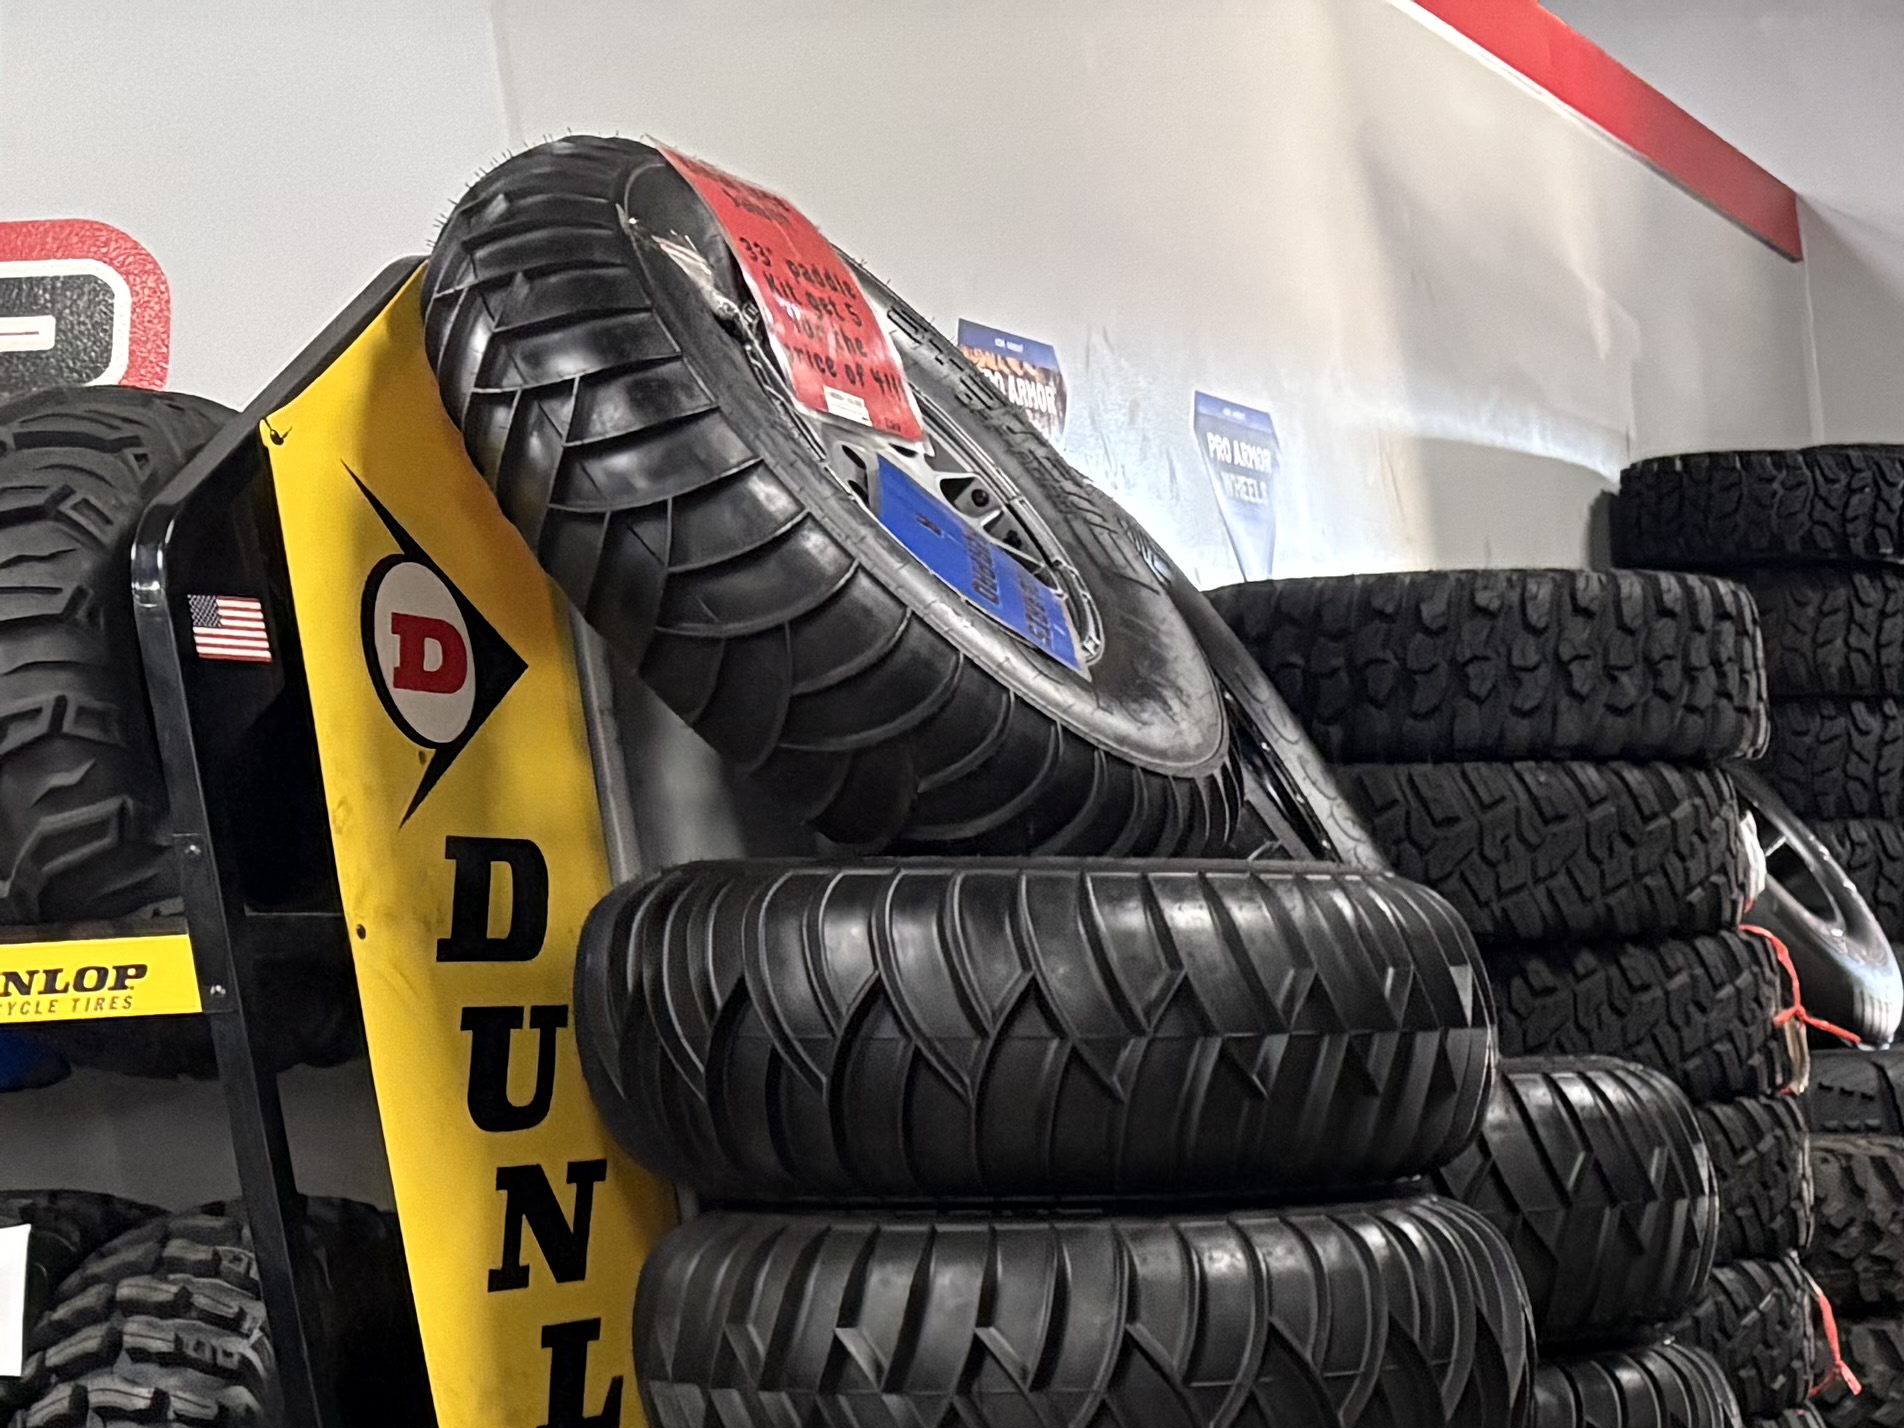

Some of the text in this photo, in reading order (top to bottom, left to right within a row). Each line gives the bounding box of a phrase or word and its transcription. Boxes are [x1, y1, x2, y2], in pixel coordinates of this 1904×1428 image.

[786, 259, 858, 301] paddle
[810, 298, 846, 323] get
[844, 302, 863, 327] 5
[845, 362, 865, 388] of
[1008, 372, 1058, 412] ARMOR
[1207, 432, 1273, 473] PRO ARMOR
[0, 995, 133, 1017] YCLE TIRES
